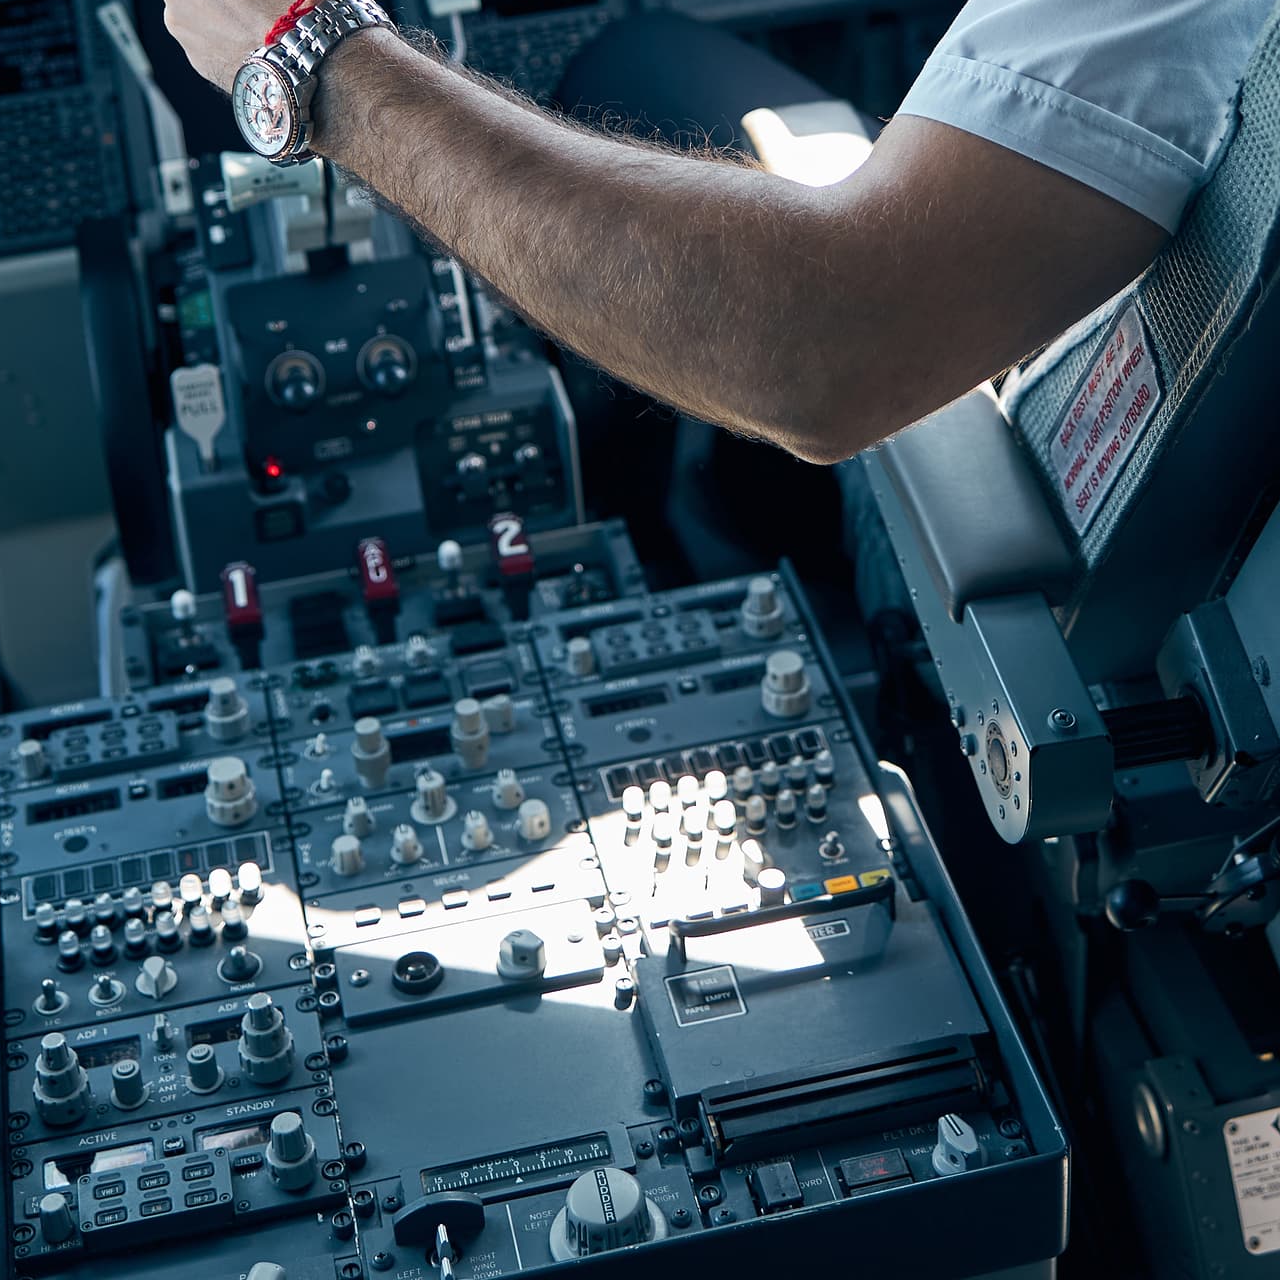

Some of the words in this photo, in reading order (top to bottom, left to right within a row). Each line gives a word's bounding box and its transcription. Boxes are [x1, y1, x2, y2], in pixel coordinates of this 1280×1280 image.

[1060, 422, 1076, 449] BACK
[1072, 390, 1089, 420] REST
[1088, 360, 1104, 396] MUST
[1105, 344, 1116, 368] BE
[1116, 330, 1125, 352] IN
[1064, 451, 1086, 493] NORMAL
[1084, 418, 1104, 456] FLIGHT
[1098, 375, 1124, 425] POSITION
[1122, 342, 1146, 382] WHEN
[1076, 480, 1092, 514] SEAT
[1090, 472, 1099, 492] IS
[1096, 435, 1120, 480] MOVING
[1120, 383, 1150, 441] OUTBOARD
[492, 520, 529, 557] 2
[228, 570, 248, 608] 1
[700, 978, 718, 987] FULL
[705, 992, 731, 1003] EMPTY
[218, 1002, 238, 1014] ADF
[684, 1004, 710, 1016] PAPER
[76, 1028, 98, 1040] ADF
[158, 1074, 176, 1083] ADF
[158, 1084, 178, 1094] ANT
[160, 1094, 177, 1103] OFF
[226, 1099, 276, 1116] STANDBY
[78, 1131, 118, 1146] ACTIVE
[240, 1156, 255, 1164] TEST
[145, 1179, 158, 1187] VHF
[101, 1189, 114, 1197] VHF
[596, 1171, 615, 1221] RUDDER
[645, 1185, 670, 1196] NOSE
[654, 1192, 680, 1203] RIGHT
[529, 1210, 554, 1220] NOSE
[524, 1220, 550, 1231] LEFT
[470, 1252, 496, 1263] RIGHT
[472, 1261, 496, 1272] WING
[396, 1268, 422, 1279] LEFT
[473, 1270, 503, 1280] DOWN
